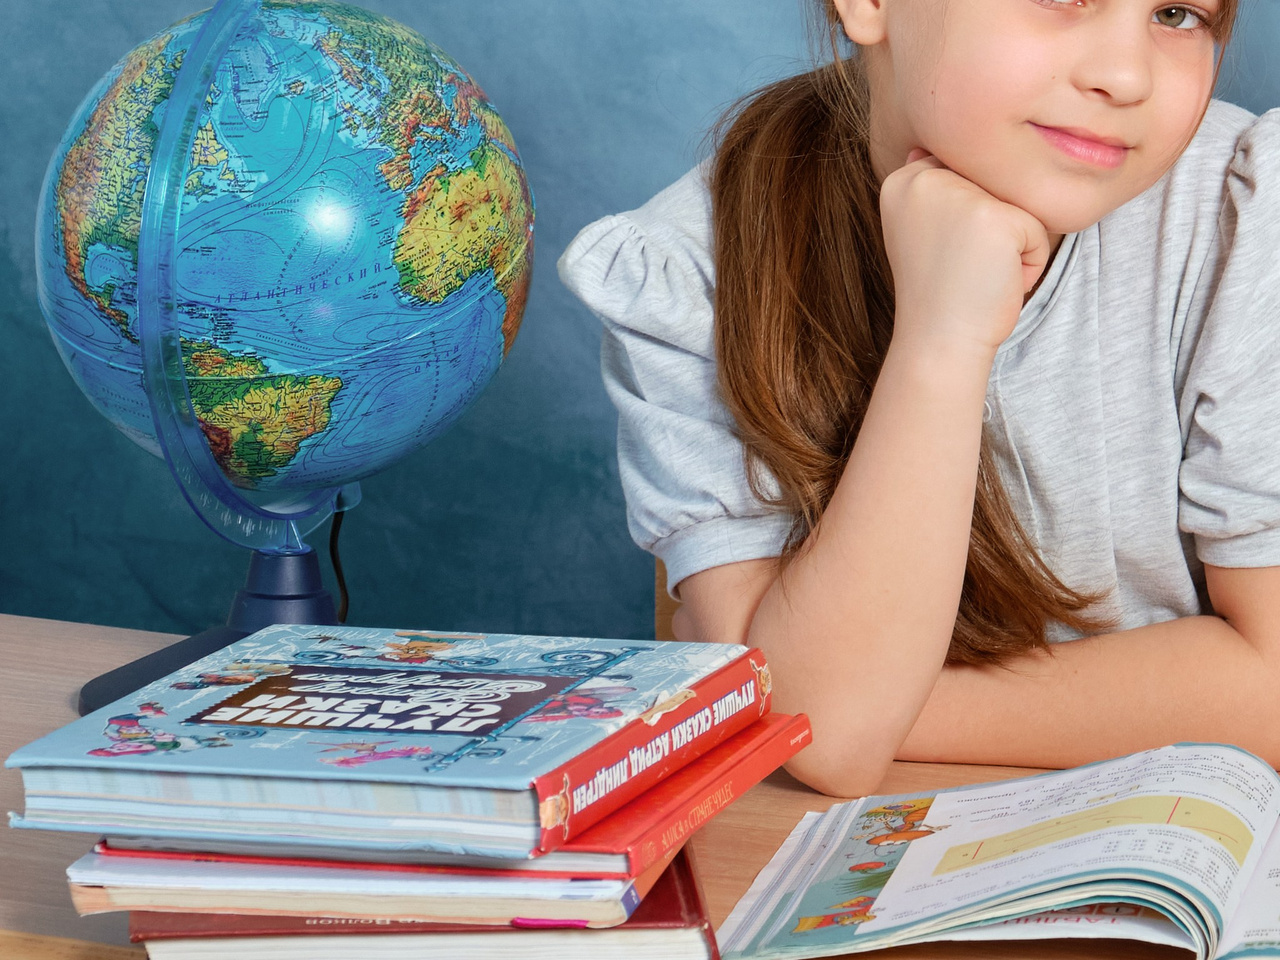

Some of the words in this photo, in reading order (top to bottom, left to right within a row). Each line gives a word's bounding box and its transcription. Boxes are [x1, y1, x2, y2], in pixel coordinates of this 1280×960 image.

[214, 262, 382, 303] АТЛАНТИЧЕСКИЙ
[201, 707, 500, 732] ЛУЧШИЕ
[241, 693, 501, 717] СКАЗКИ
[713, 679, 755, 724] ЛУЧШИЕ
[672, 706, 713, 751] СКАЗКИ
[629, 731, 670, 777] АСТРИД
[572, 757, 629, 815] ЛИНДГРЕН
[661, 820, 685, 851] АЛИСА
[688, 794, 715, 829] СТРАНЕ
[711, 780, 734, 809] ЧУДЕС
